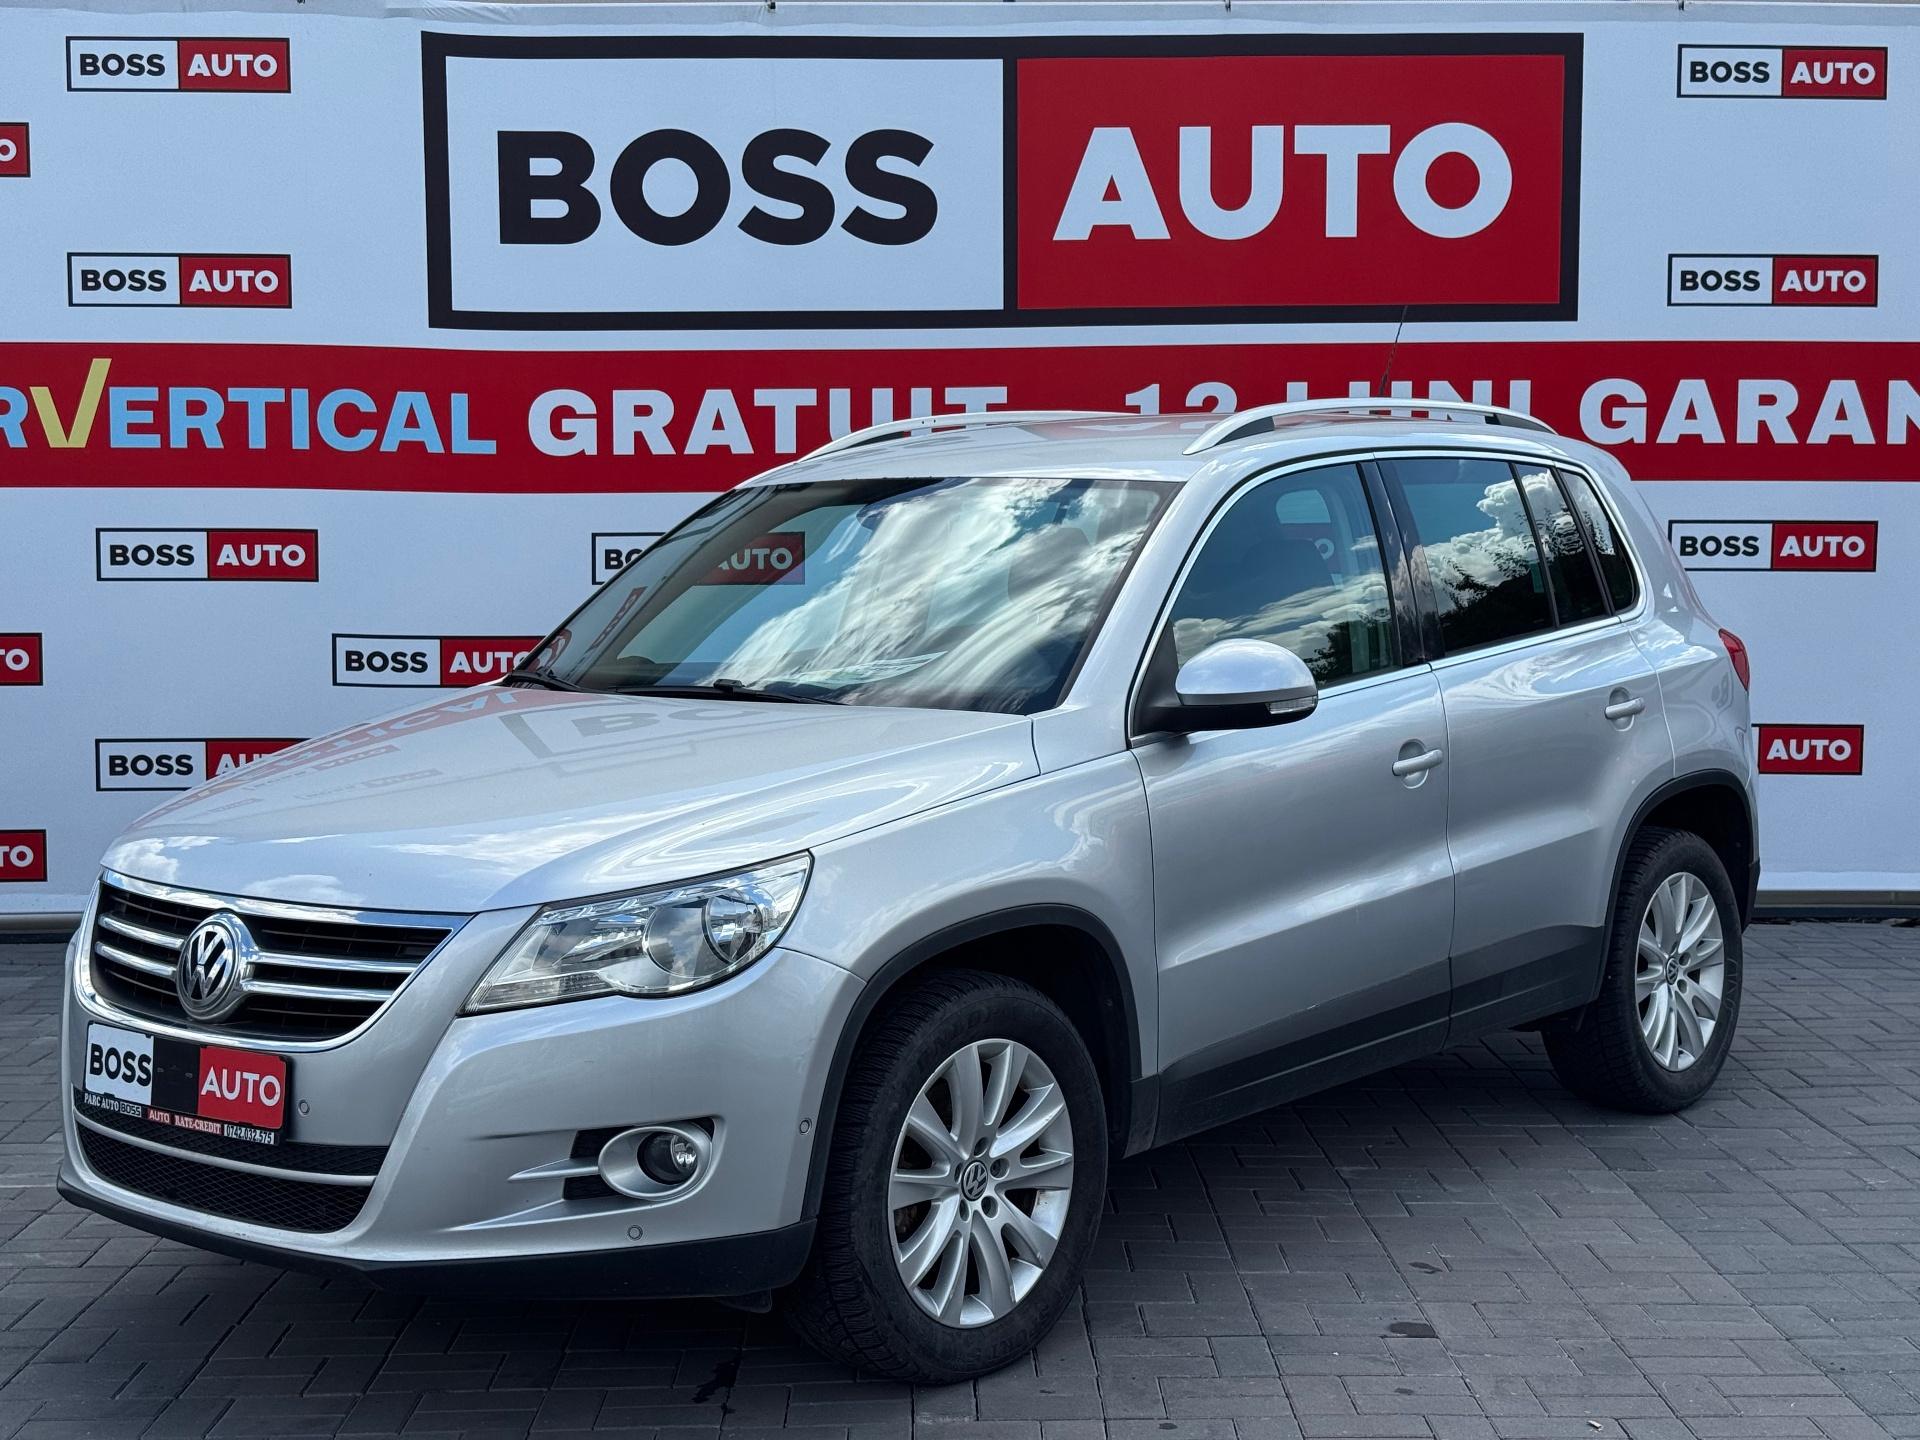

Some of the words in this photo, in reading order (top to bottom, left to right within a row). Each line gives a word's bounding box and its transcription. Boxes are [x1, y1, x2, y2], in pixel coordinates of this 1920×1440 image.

[80, 54, 165, 77] BOSS
[187, 54, 277, 77] AUTO
[1690, 62, 1769, 83] BOSS
[1791, 62, 1876, 84] AUTO
[497, 129, 938, 246] BOSS
[1053, 123, 1513, 240] AUTO
[81, 270, 166, 292] BOSS
[189, 270, 278, 293] AUTO
[1680, 270, 1760, 292] BOSS
[1781, 270, 1866, 292] AUTO
[110, 545, 195, 566] BOSS
[217, 544, 305, 566] AUTO
[1679, 536, 1760, 557] BOSS
[1780, 536, 1865, 557] AUTO
[345, 651, 428, 673] BOSS
[1766, 739, 1851, 760] AUTO
[109, 755, 193, 776] BOSS
[89, 1042, 152, 1087] BOSS
[200, 1066, 281, 1107] AUTO
[84, 1092, 101, 1107] PARC
[101, 1098, 119, 1112] AUTO
[121, 1103, 141, 1117] BOSS
[148, 1109, 170, 1123] AUTO
